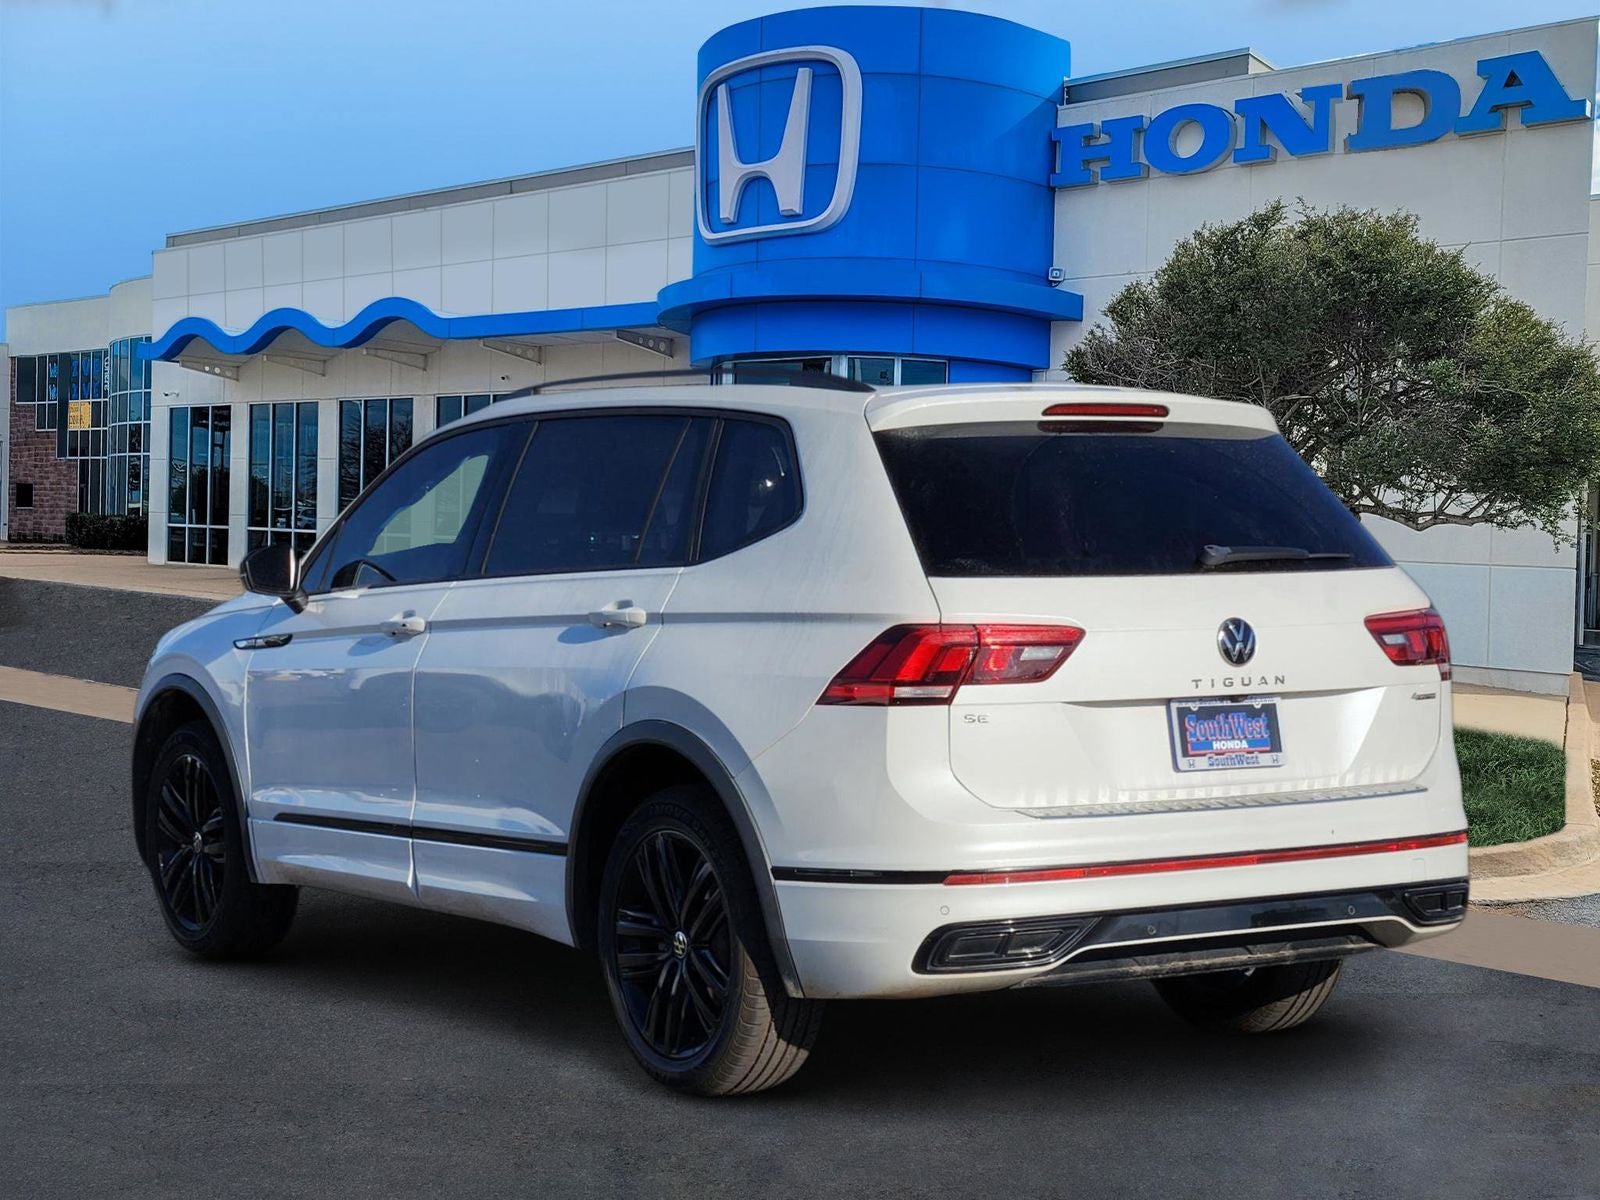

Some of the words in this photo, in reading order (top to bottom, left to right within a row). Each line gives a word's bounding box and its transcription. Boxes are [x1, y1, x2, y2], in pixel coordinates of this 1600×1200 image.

[1051, 51, 1591, 187] HONDA
[1191, 675, 1286, 689] TIGUAN
[964, 714, 990, 724] SE
[1185, 713, 1270, 740] SouthWest
[1212, 740, 1249, 750] HONDA
[1208, 755, 1260, 767] SouthWest
